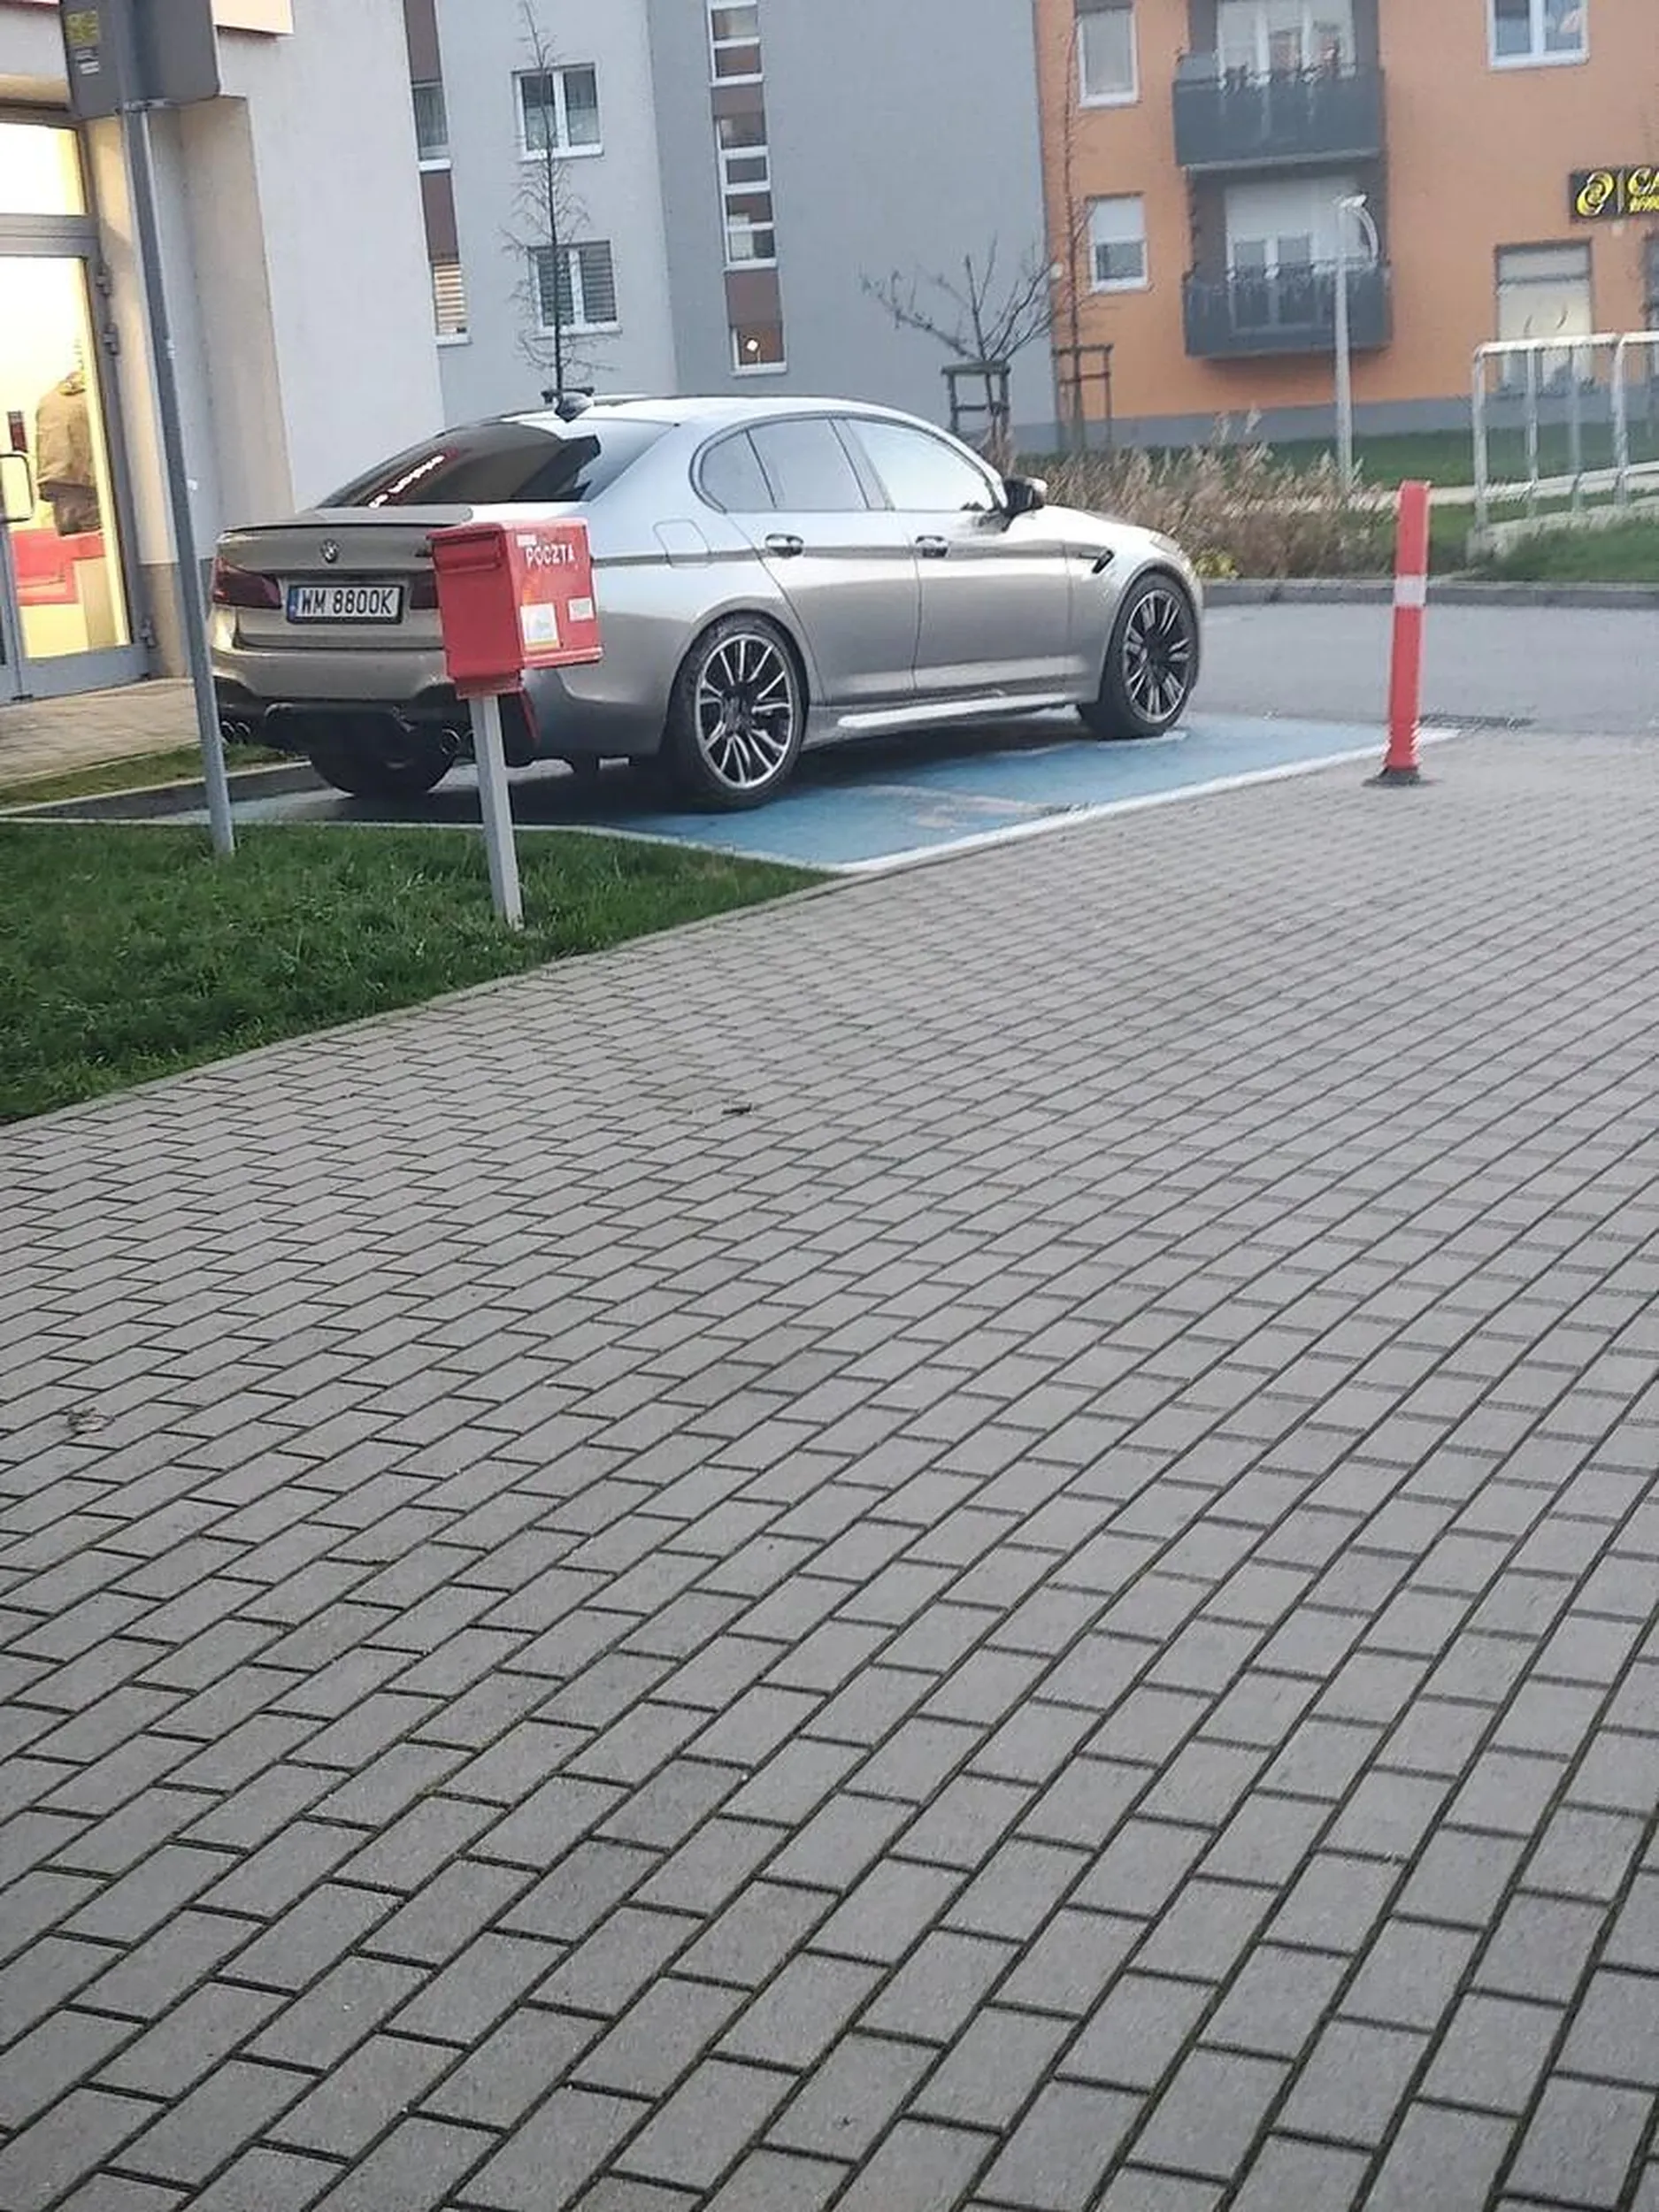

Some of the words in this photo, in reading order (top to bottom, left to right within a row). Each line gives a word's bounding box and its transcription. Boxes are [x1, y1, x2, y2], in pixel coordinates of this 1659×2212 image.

[526, 543, 575, 568] POCZTA
[302, 589, 326, 614] WM
[333, 589, 394, 614] 8800K
